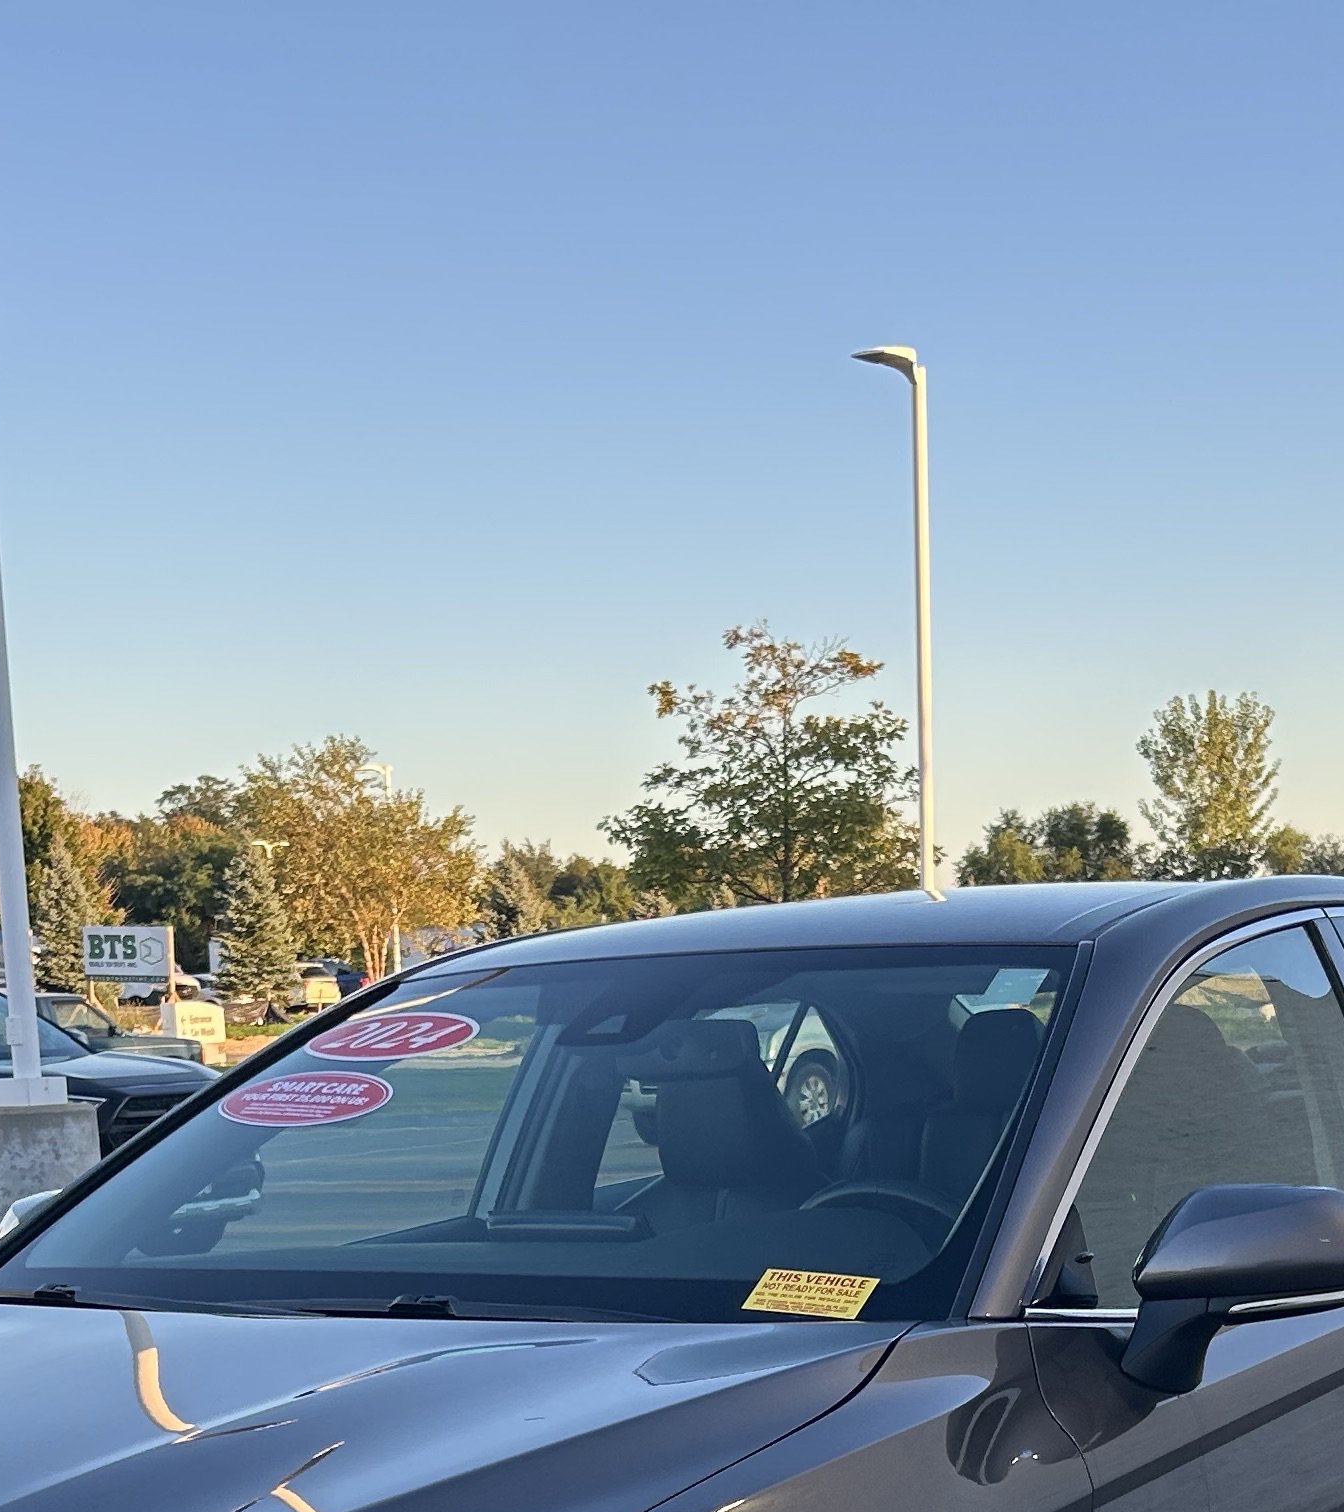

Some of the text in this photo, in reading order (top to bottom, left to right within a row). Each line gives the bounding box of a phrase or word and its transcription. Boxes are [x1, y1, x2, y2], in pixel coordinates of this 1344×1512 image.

[88, 935, 137, 959] BTS
[320, 1021, 467, 1050] 2024
[267, 1081, 370, 1096] SMART CARE
[767, 1271, 871, 1289] THIS VEHICLE
[762, 1282, 862, 1298] NOT READY FOR SALE
